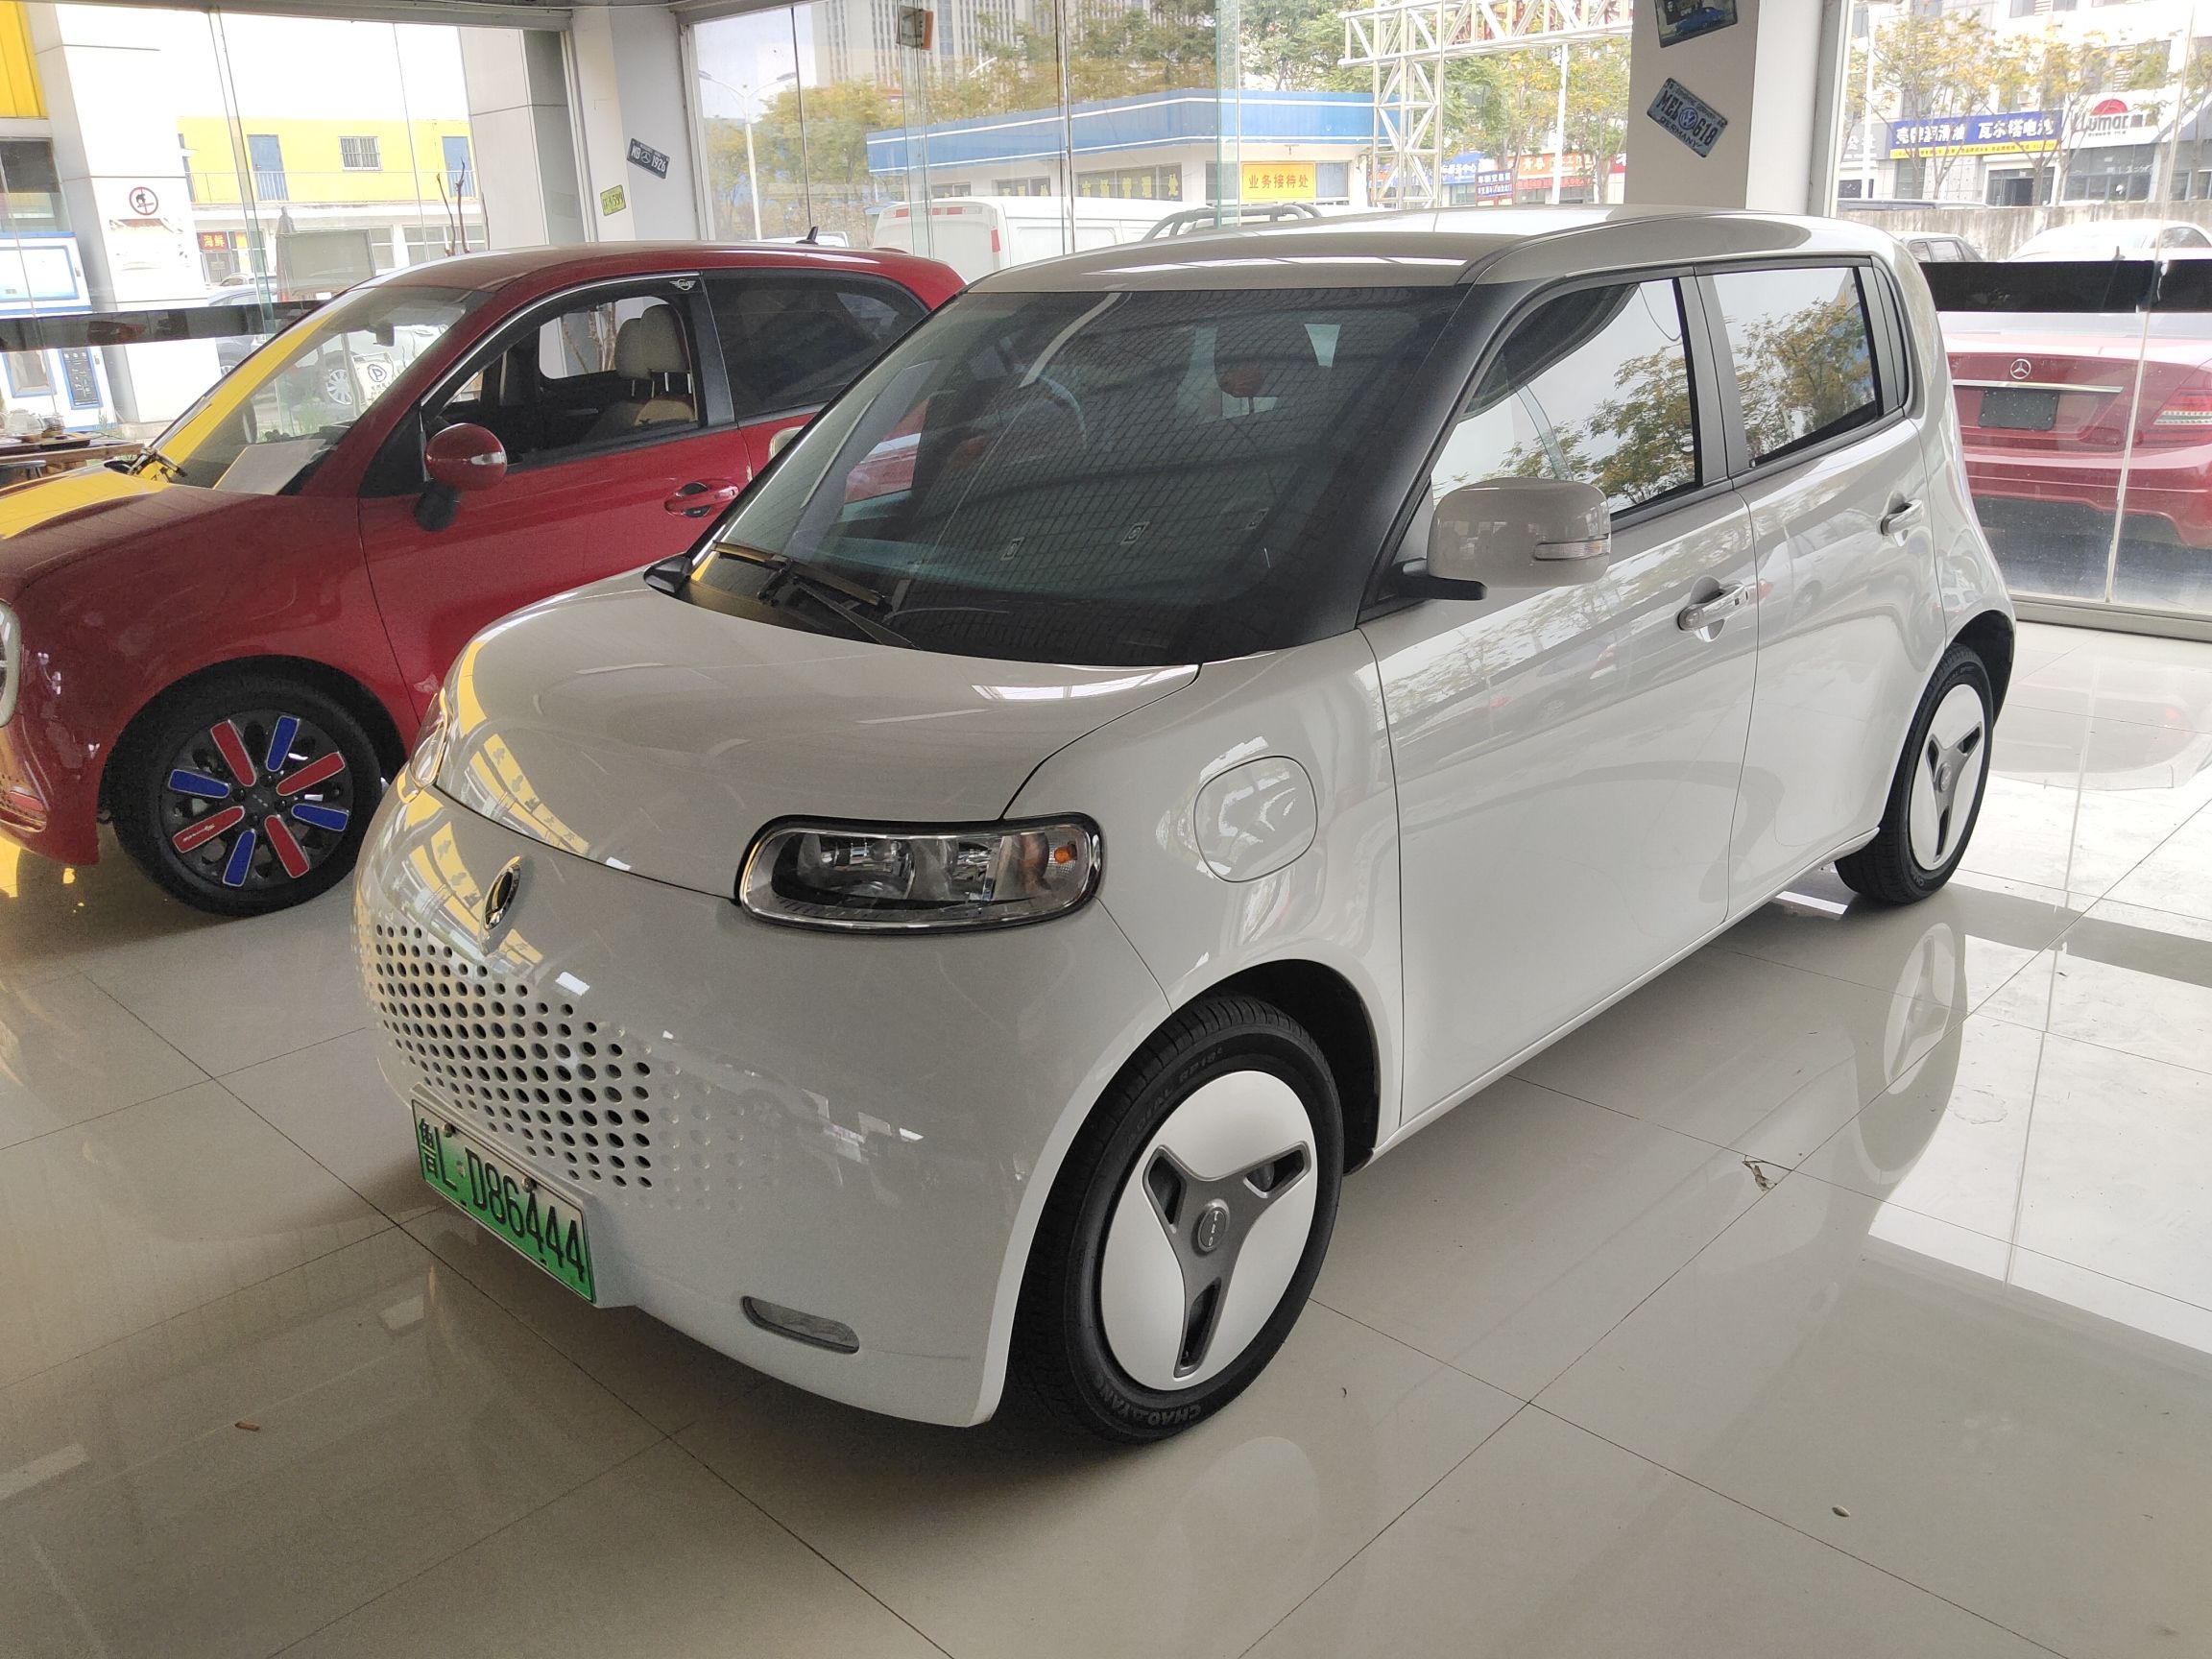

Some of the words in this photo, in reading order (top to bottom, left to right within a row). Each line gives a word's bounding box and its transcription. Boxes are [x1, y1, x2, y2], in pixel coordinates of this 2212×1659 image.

[1693, 118, 1719, 146] 618
[651, 155, 666, 172] 1926
[1248, 174, 1309, 189] 业务接待处
